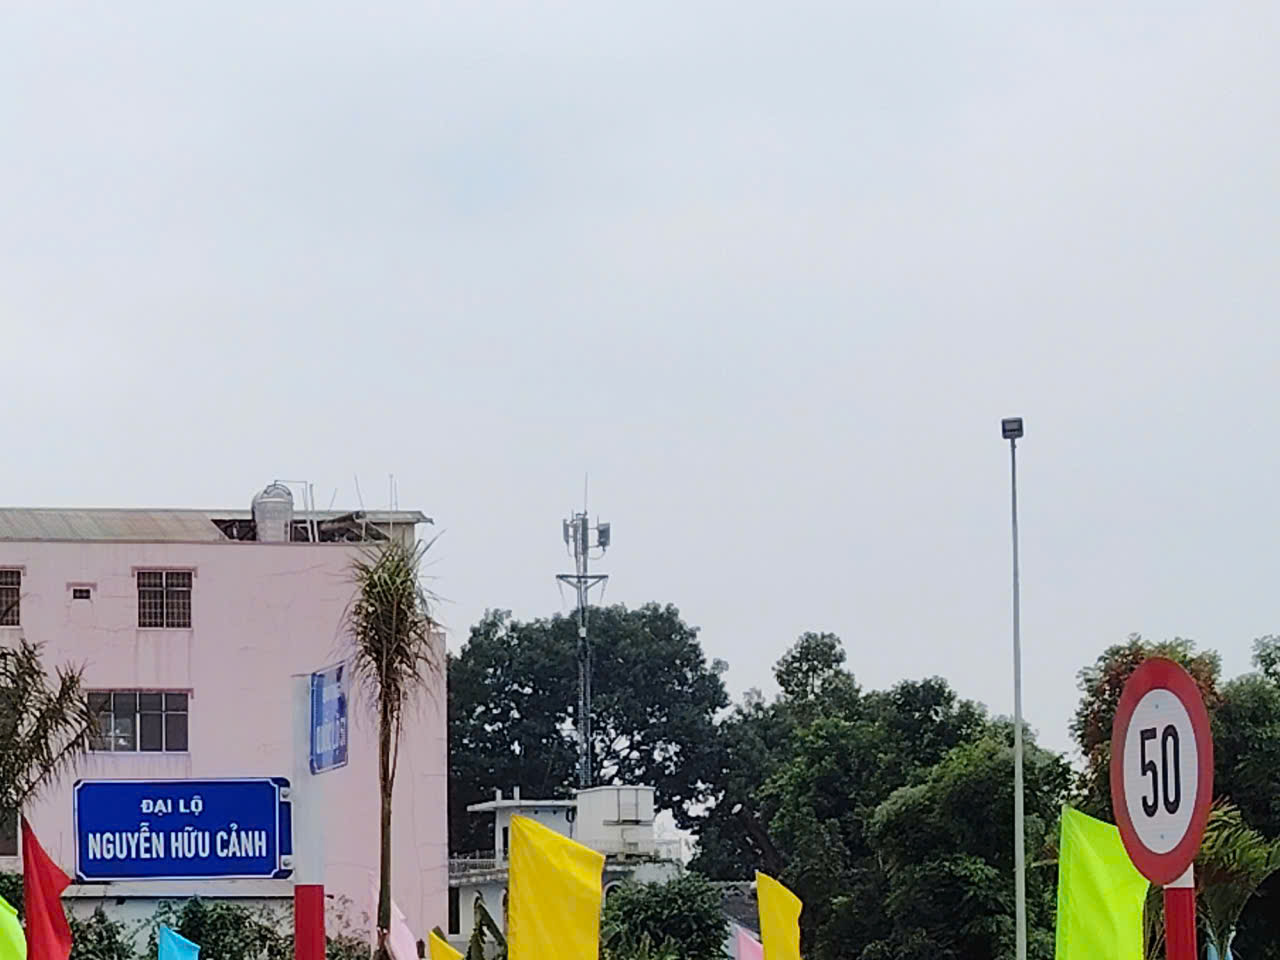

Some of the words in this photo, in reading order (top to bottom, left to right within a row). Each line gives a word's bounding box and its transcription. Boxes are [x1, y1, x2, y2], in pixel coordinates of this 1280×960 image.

[1140, 724, 1181, 818] 50
[141, 799, 172, 816] ĐẠI
[179, 796, 203, 815] LỘ
[88, 822, 165, 860] NGUYỄN
[170, 826, 210, 858] HỮU
[216, 823, 267, 857] CẢNH
